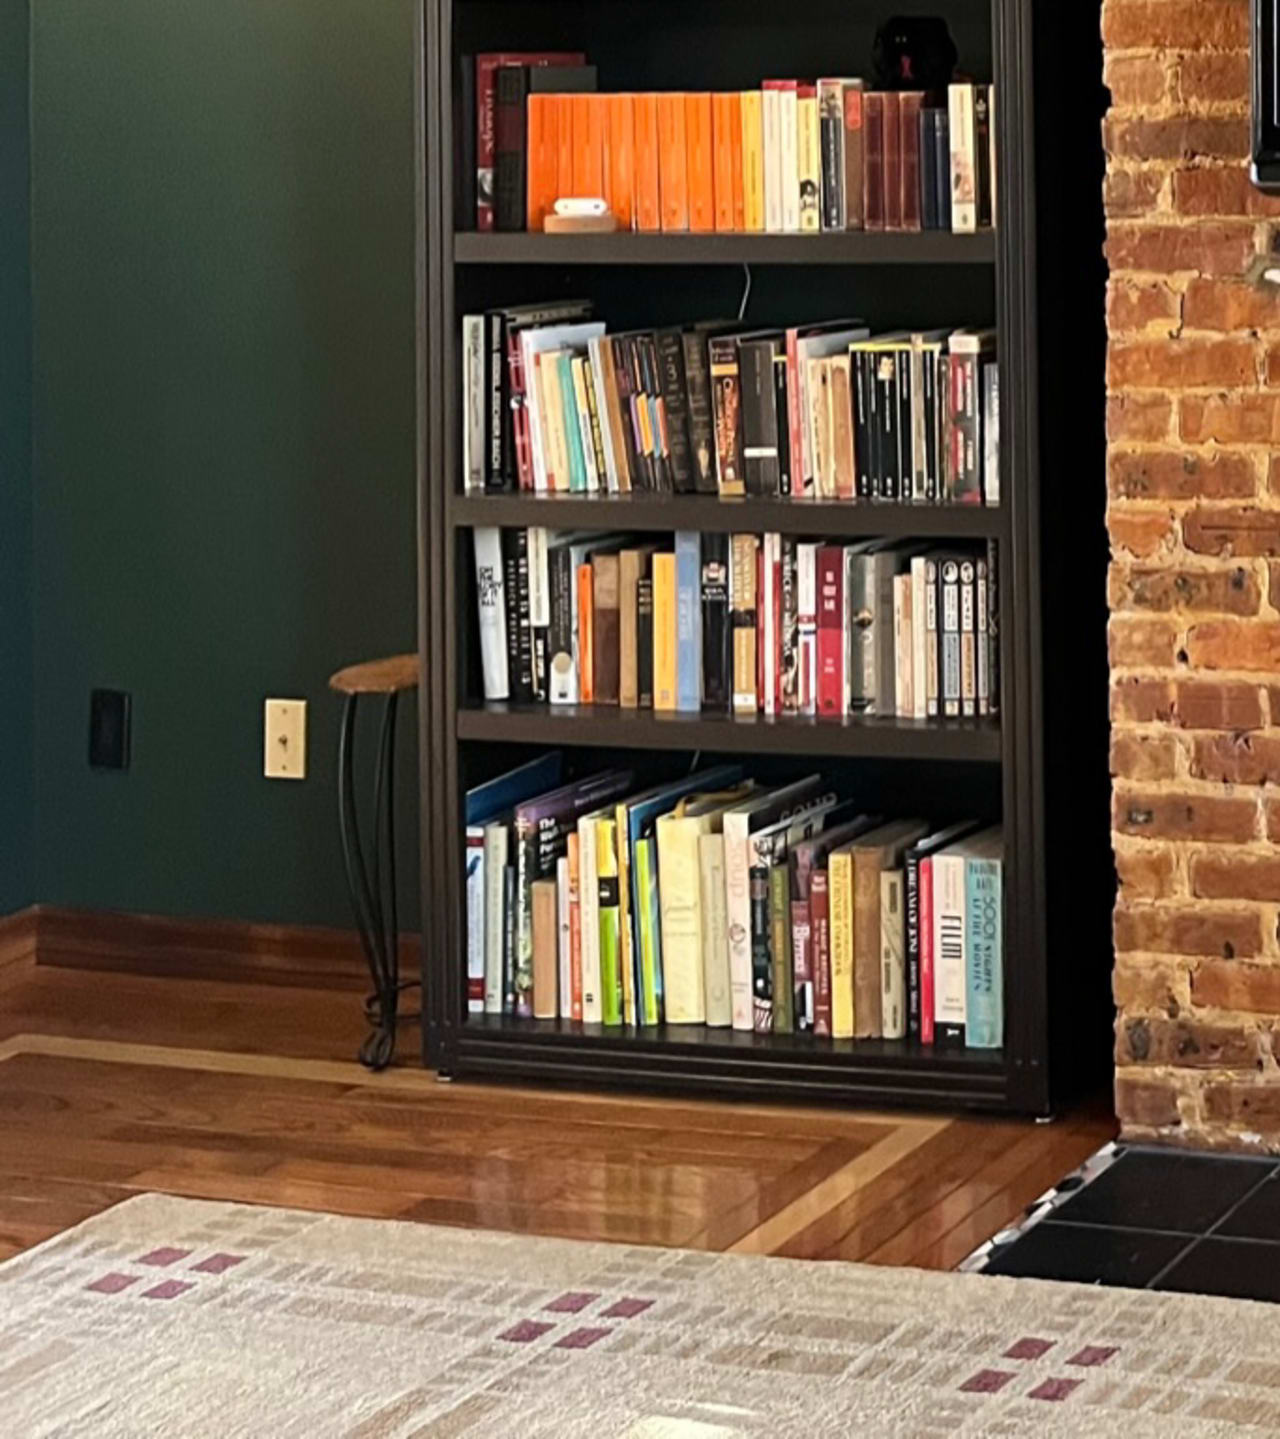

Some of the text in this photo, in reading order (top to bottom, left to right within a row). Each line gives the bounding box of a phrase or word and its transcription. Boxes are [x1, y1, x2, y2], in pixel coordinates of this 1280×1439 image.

[940, 915, 962, 959] FILM
[983, 896, 996, 940] 5001
[973, 943, 982, 991] MOVIES
